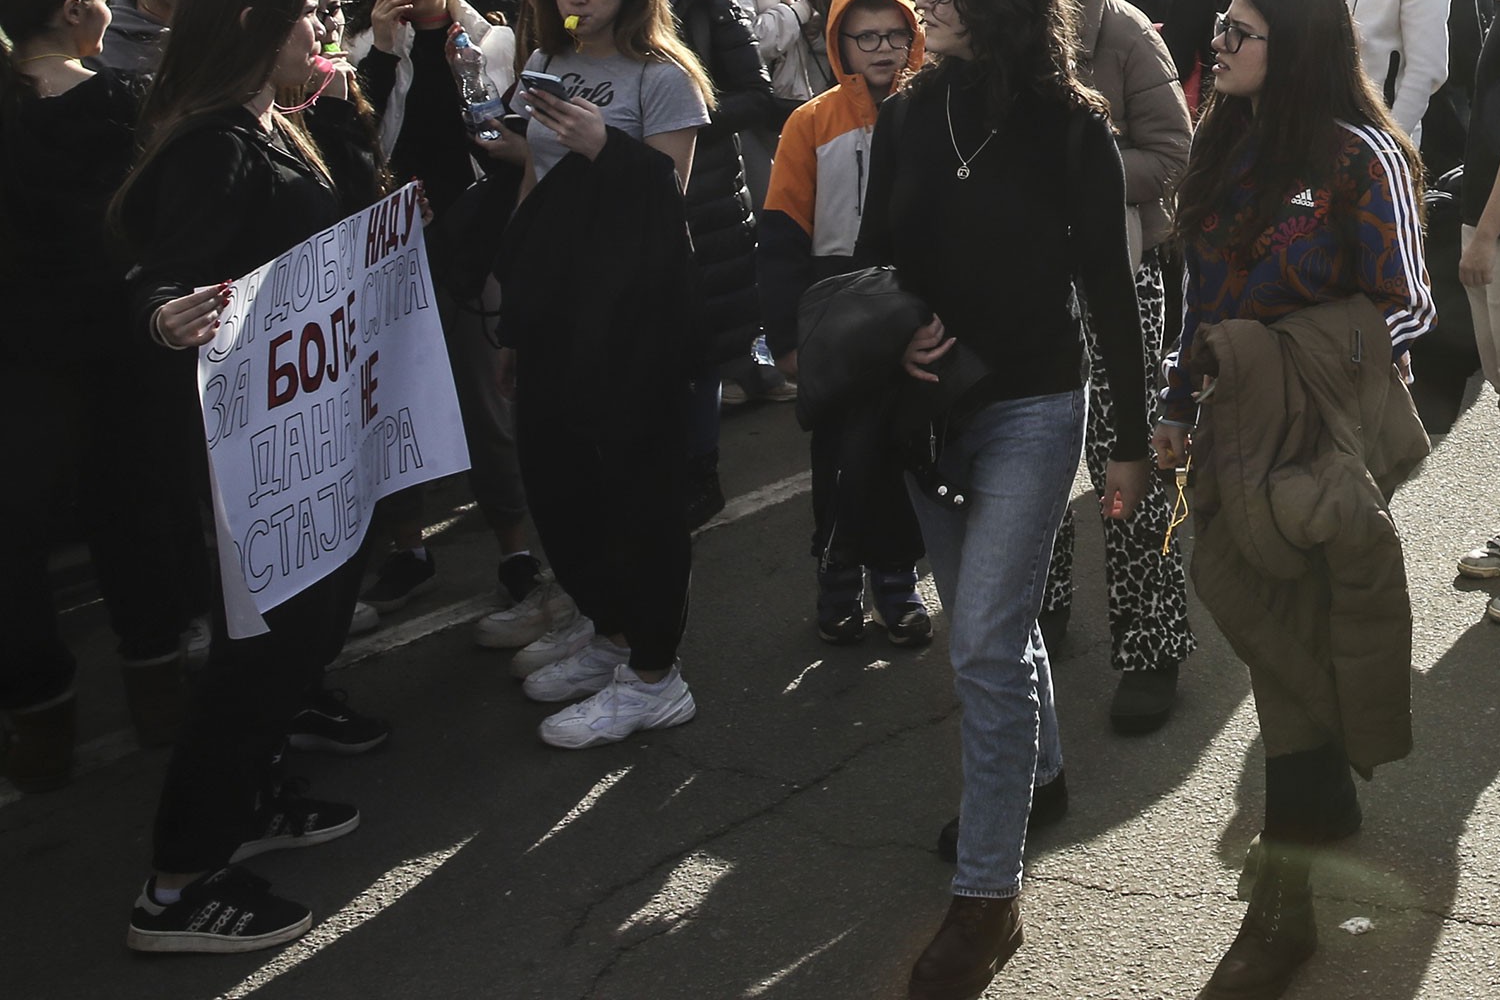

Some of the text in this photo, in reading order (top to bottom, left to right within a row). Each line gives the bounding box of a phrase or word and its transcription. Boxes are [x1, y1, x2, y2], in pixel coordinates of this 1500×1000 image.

[264, 216, 362, 332] ДОБРУ
[364, 184, 418, 270] НАДУ
[205, 247, 428, 450] ЗА БОЛЕ СУТРА
[360, 349, 379, 431] НЕ
